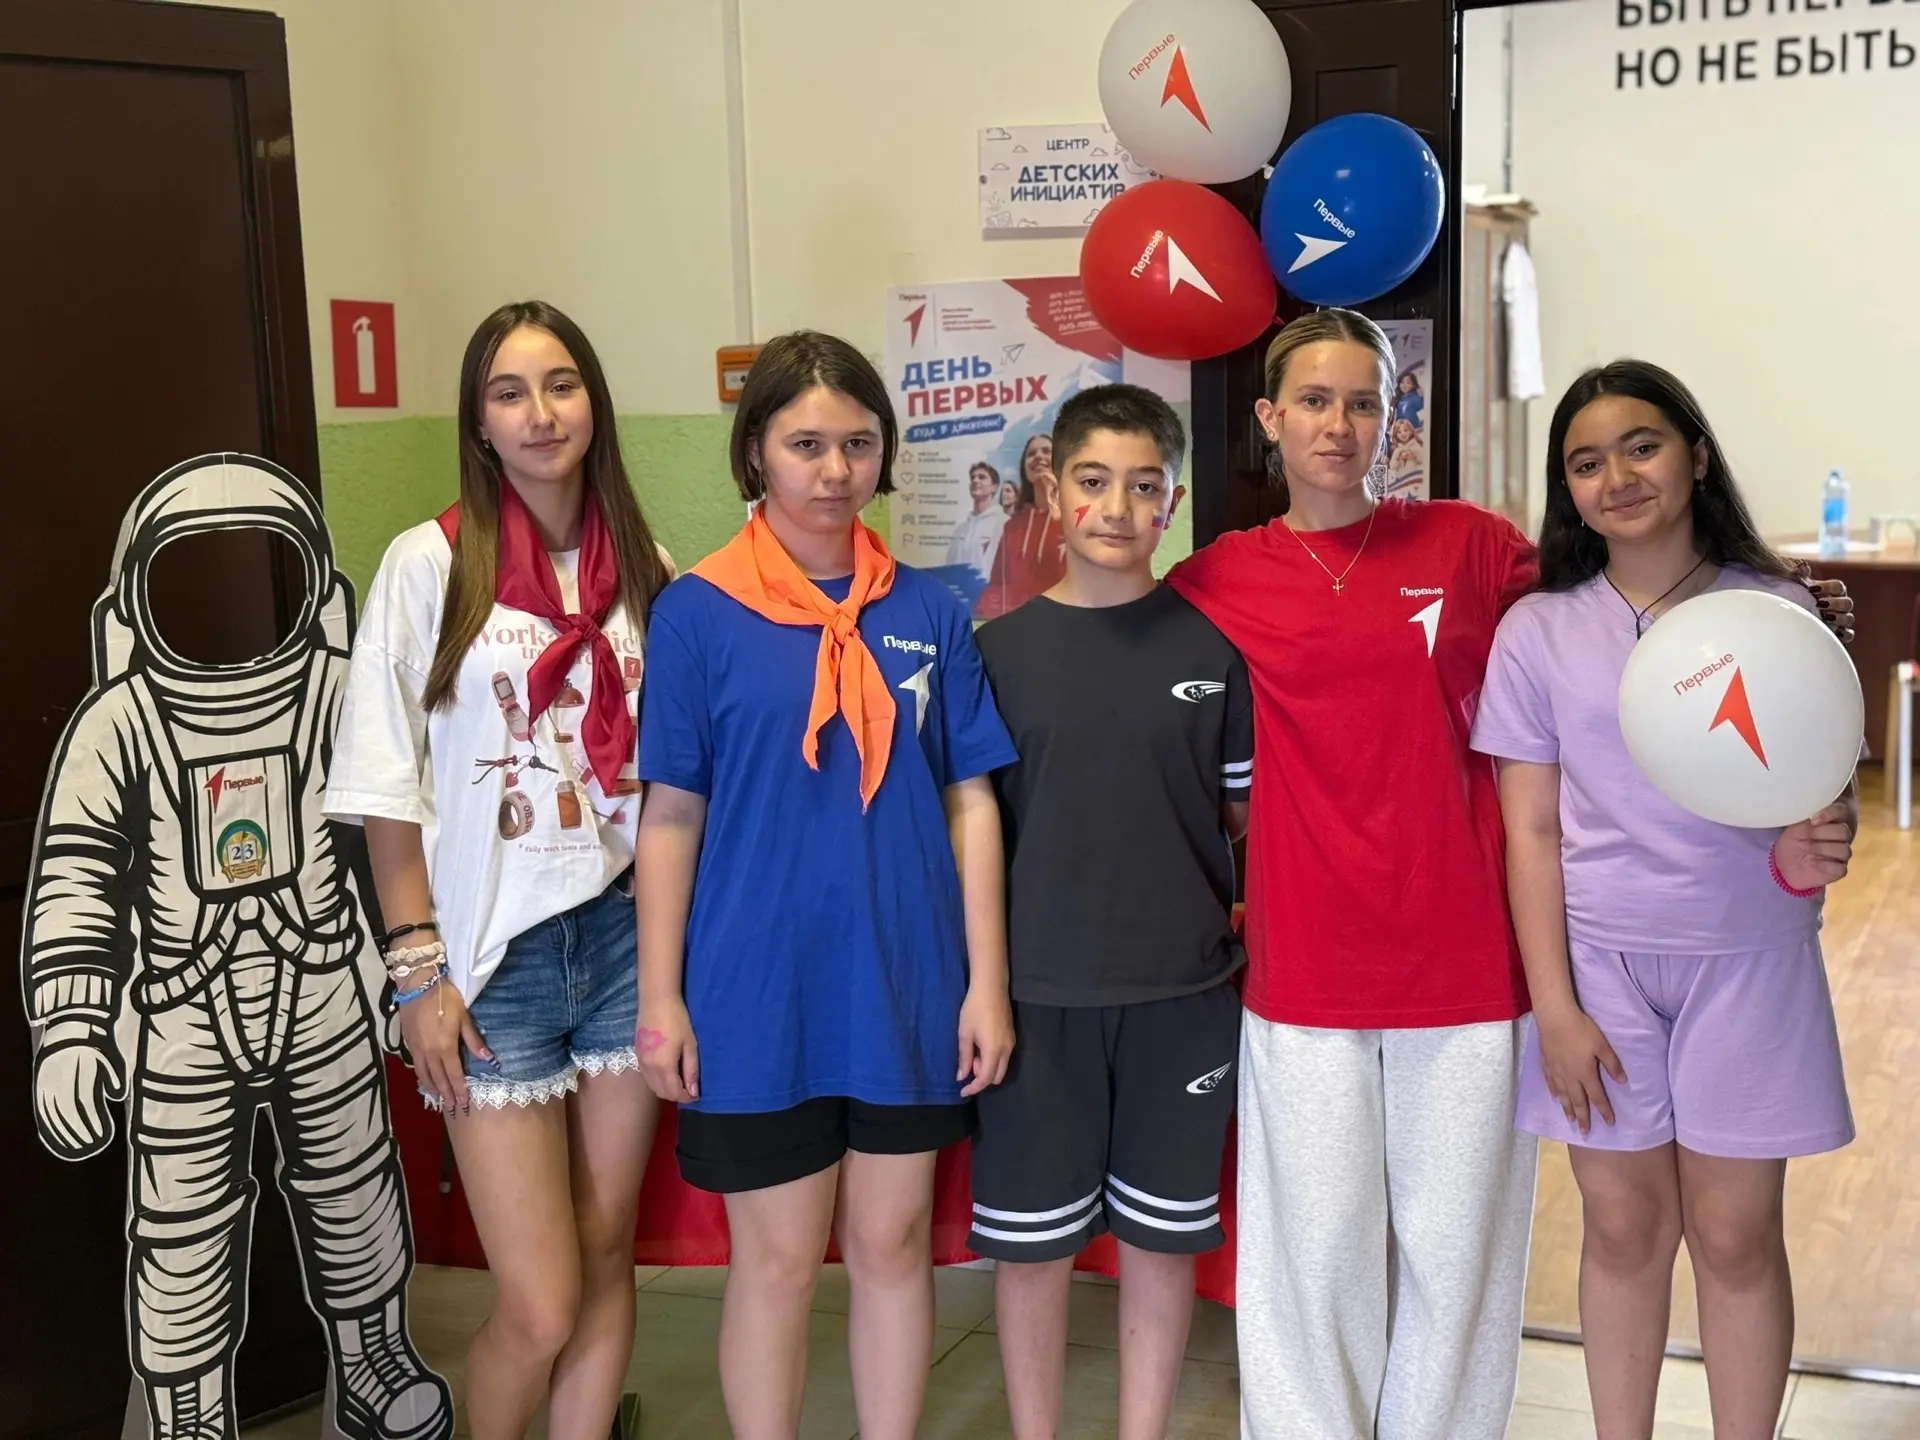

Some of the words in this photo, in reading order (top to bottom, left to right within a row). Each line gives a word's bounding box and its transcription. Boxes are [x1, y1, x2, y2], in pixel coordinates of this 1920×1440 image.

[1128, 33, 1175, 80] Первые
[1616, 48, 1681, 89] НО
[1698, 40, 1757, 83] НЕ
[1776, 28, 1916, 76] БЫТЬ
[1046, 138, 1090, 151] ЦЕНТР
[1017, 163, 1119, 183] ДЕТСКИХ
[1312, 198, 1356, 239] Первые
[1130, 229, 1163, 278] Первые
[901, 355, 993, 391] ДЕНЬ
[907, 374, 1049, 417] ПЕРВЫХ
[1400, 587, 1444, 598] Первые
[883, 635, 937, 656] Первые
[1673, 653, 1735, 696] Первые
[223, 776, 264, 791] Первые
[231, 844, 254, 860] 23
